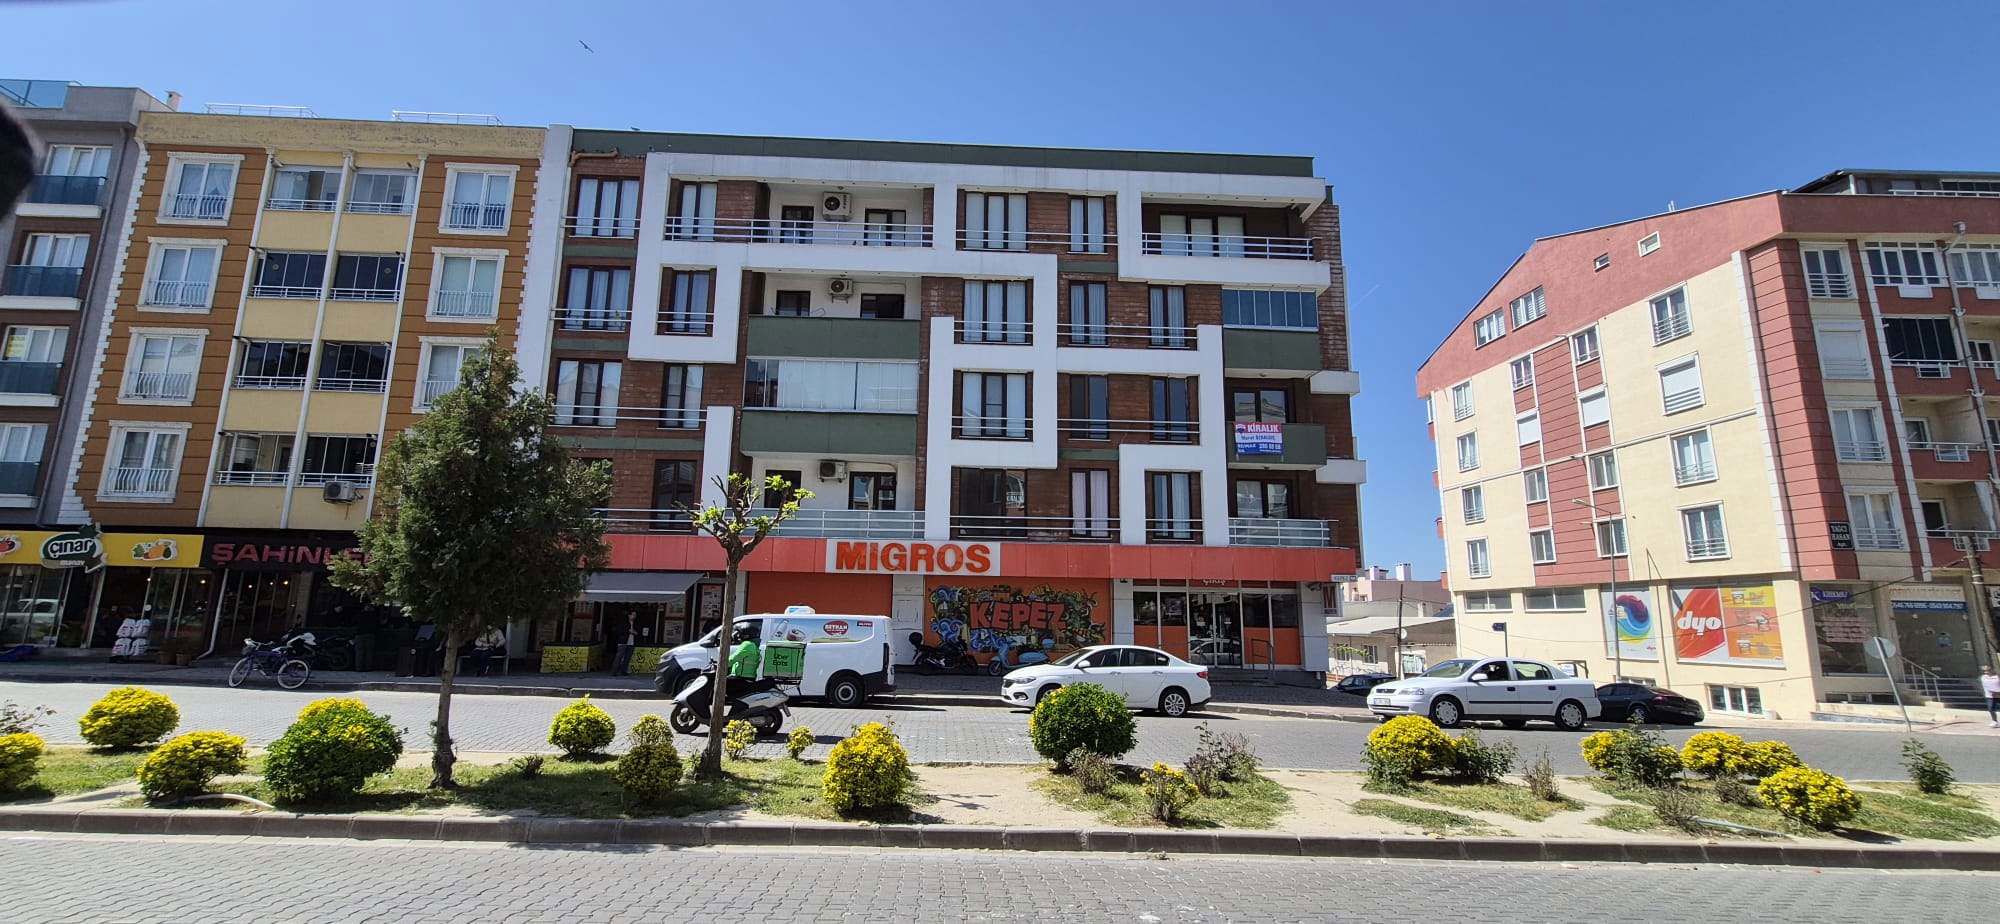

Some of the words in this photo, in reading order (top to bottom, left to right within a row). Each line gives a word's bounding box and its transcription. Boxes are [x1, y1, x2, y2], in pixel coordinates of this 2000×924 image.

[1247, 423, 1279, 432] KİRALIK
[836, 542, 991, 573] MIGROS
[969, 601, 1067, 631] KEPEZ
[1677, 611, 1721, 635] dyo
